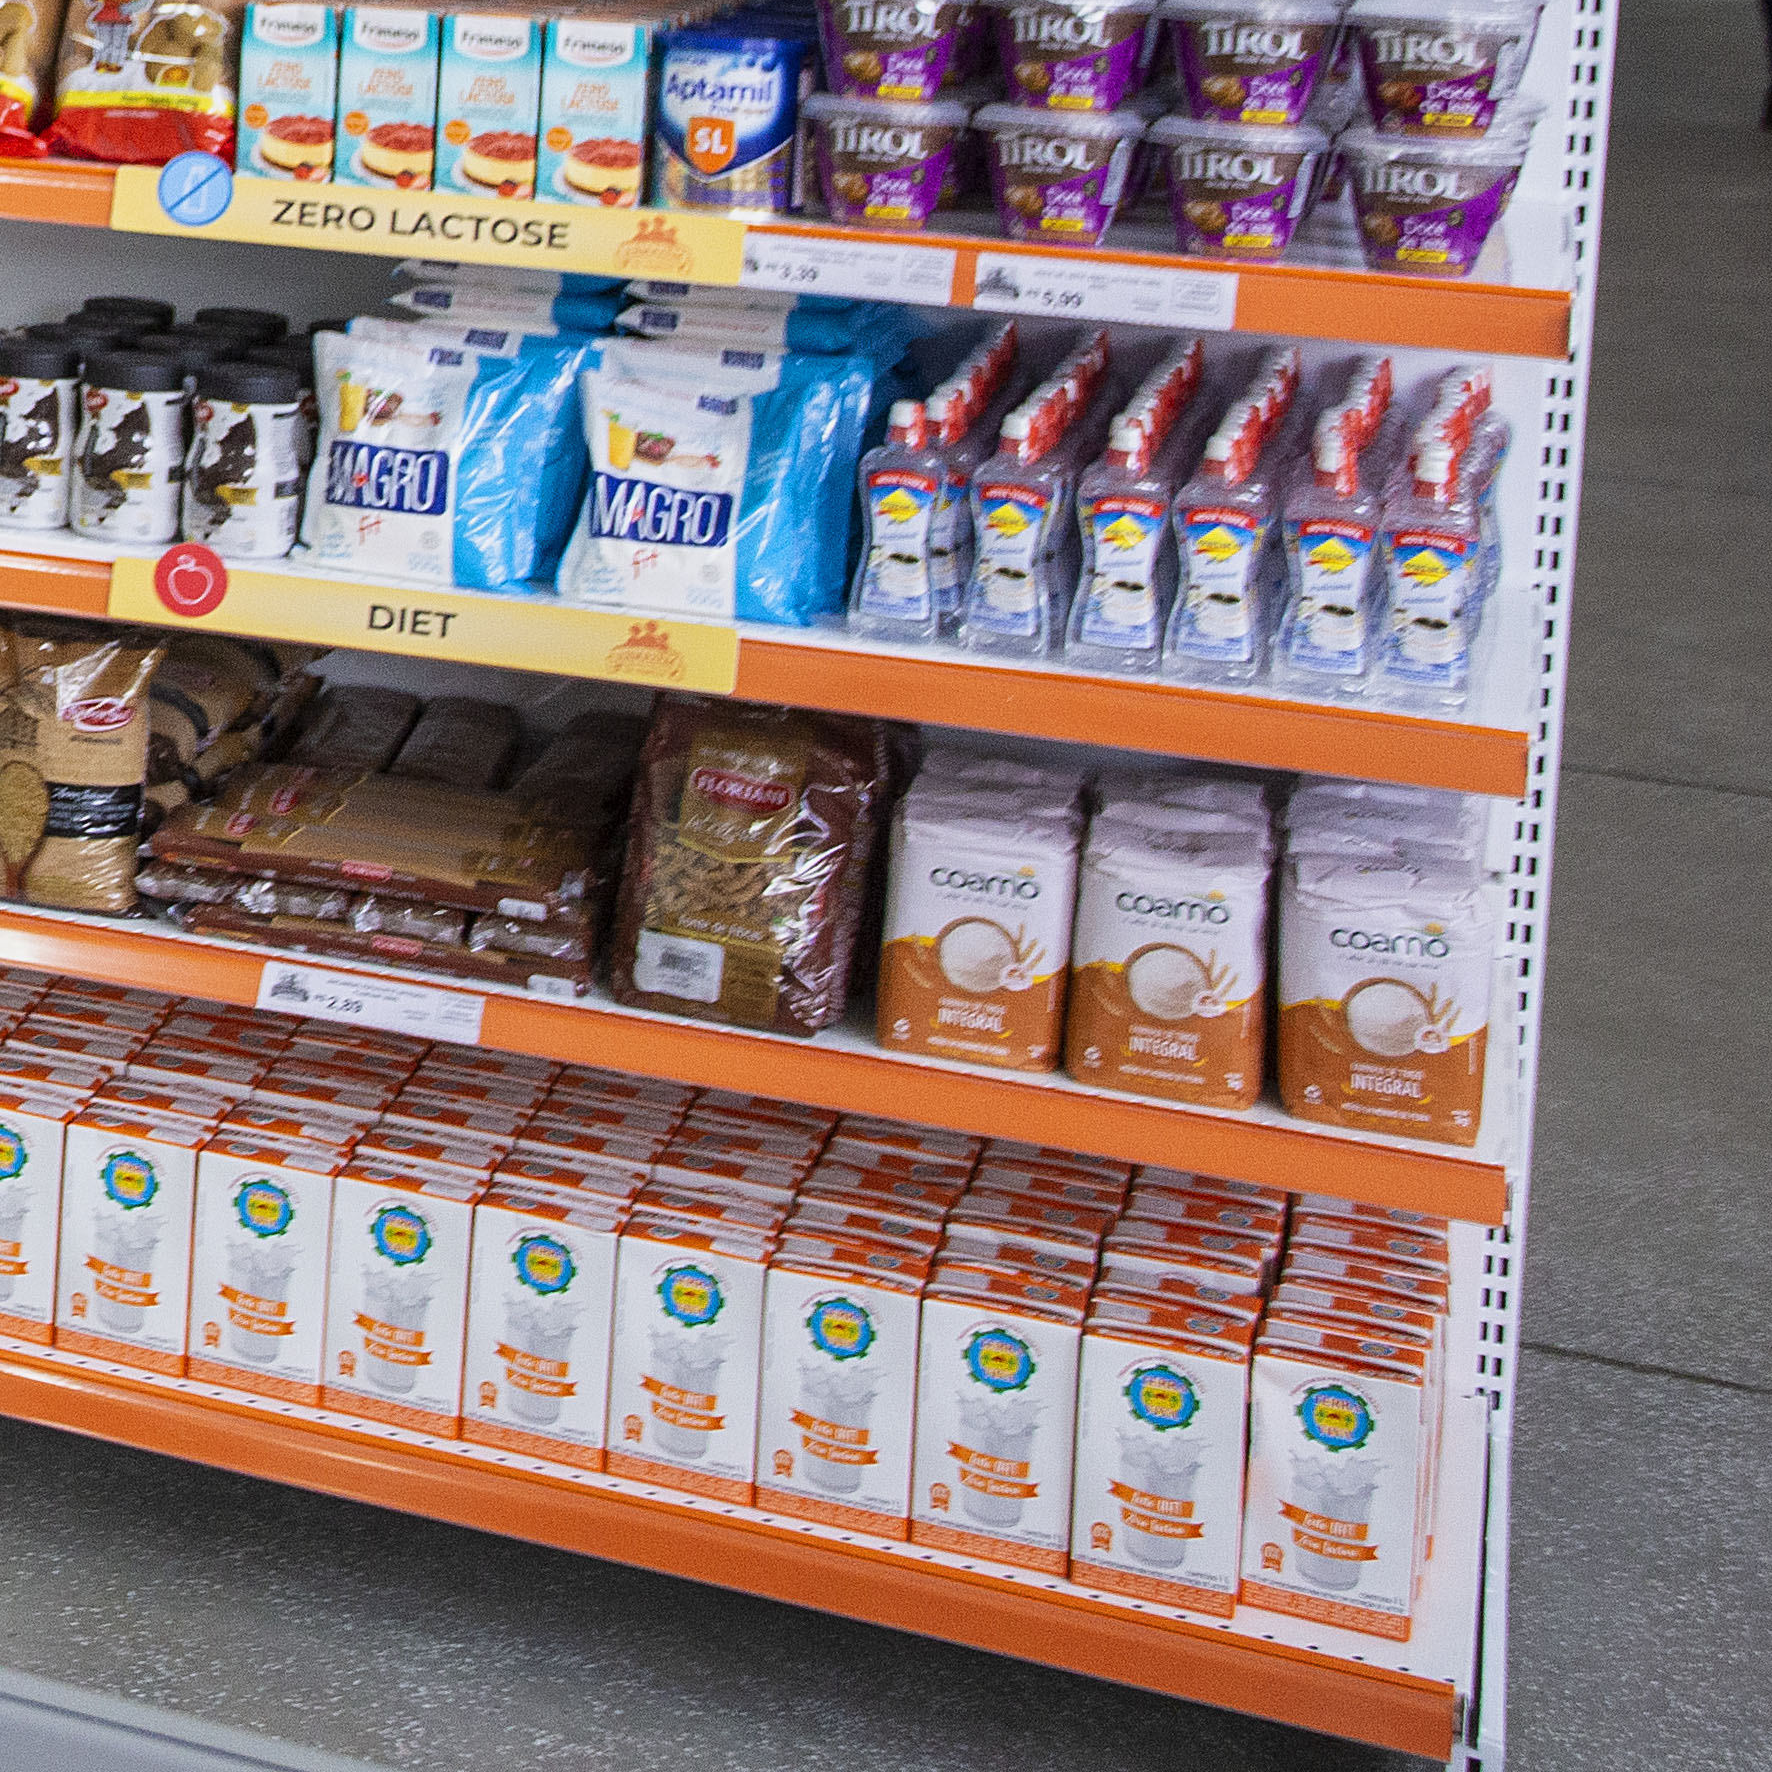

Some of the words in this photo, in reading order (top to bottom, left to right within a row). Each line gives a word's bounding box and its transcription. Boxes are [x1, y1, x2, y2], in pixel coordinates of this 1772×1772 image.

[1013, 6, 1114, 50] TIROL
[1201, 19, 1309, 63] TIROL
[1373, 30, 1486, 73] TIROL
[664, 71, 775, 109] Aptamil
[693, 125, 730, 156] SL
[831, 118, 931, 163] TIROL
[995, 128, 1097, 171] TIROL
[1178, 144, 1286, 187] TIROL
[1361, 161, 1468, 201] TIROL
[271, 198, 378, 234] ZERO
[389, 202, 571, 249] LACTOSE
[329, 440, 441, 515] MAGRO
[593, 473, 721, 545] MAGRO
[368, 604, 459, 639] DIET
[929, 865, 1039, 903] coamo
[1115, 886, 1230, 926] coamo
[1329, 922, 1451, 959] coamo
[938, 1005, 1005, 1034] INTEGRAL
[1128, 1034, 1197, 1062] INTEGRAL
[1350, 1071, 1422, 1099] INTEGRAL
